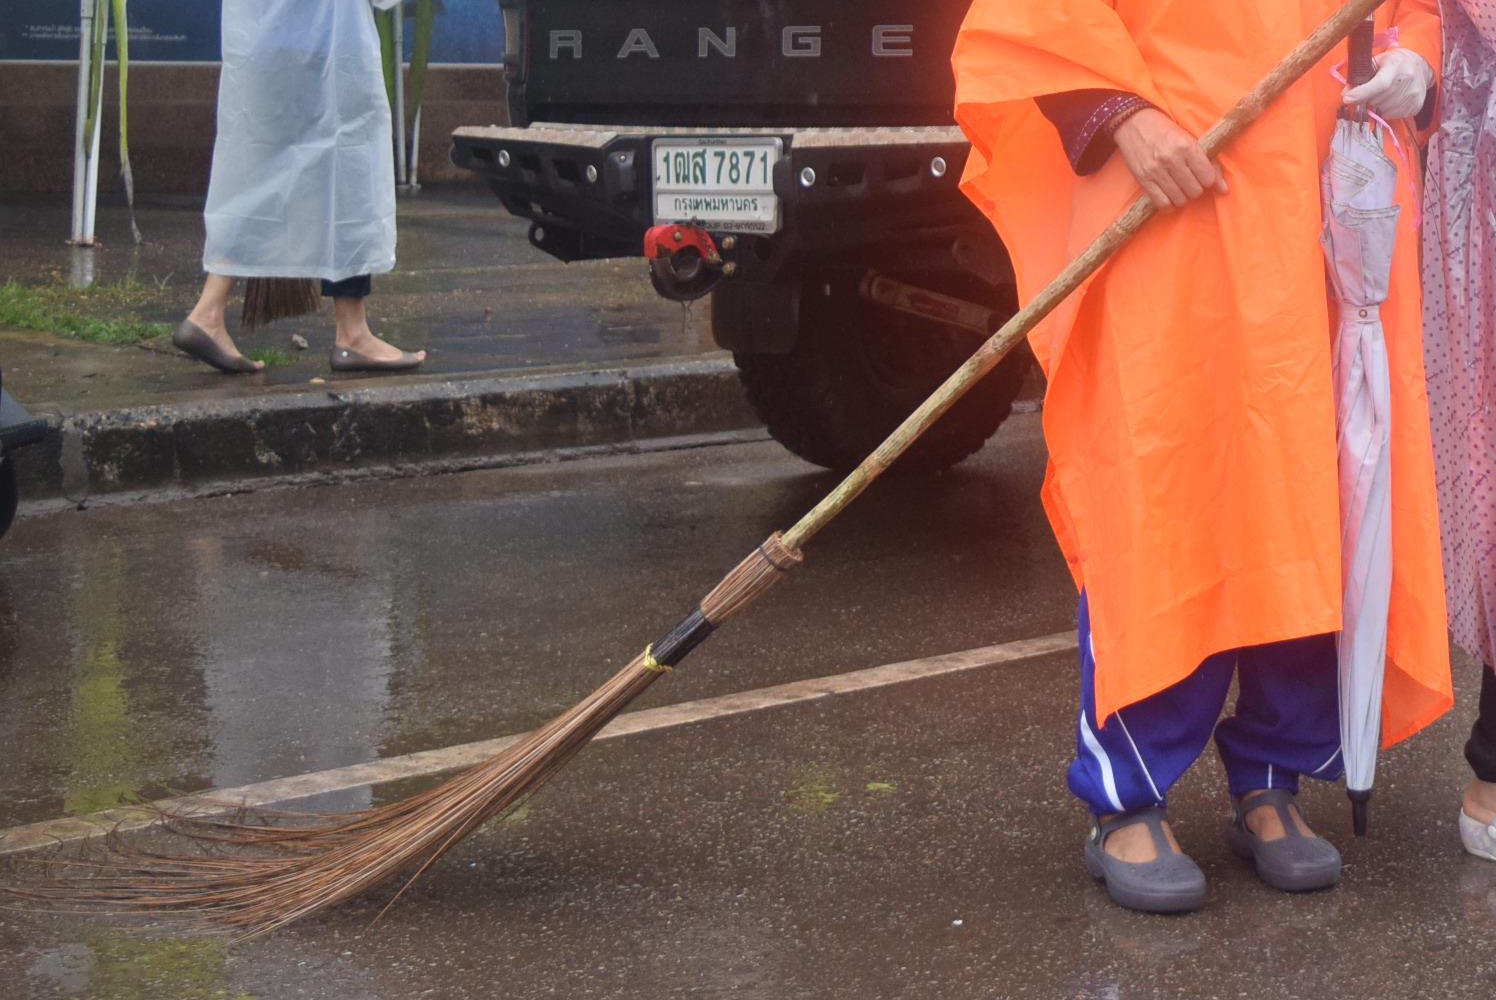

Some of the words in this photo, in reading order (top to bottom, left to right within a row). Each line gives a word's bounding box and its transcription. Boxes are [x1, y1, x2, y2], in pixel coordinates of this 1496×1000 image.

[713, 150, 768, 185] 7871
[674, 197, 759, 216] กรุงเทพมหานคร
